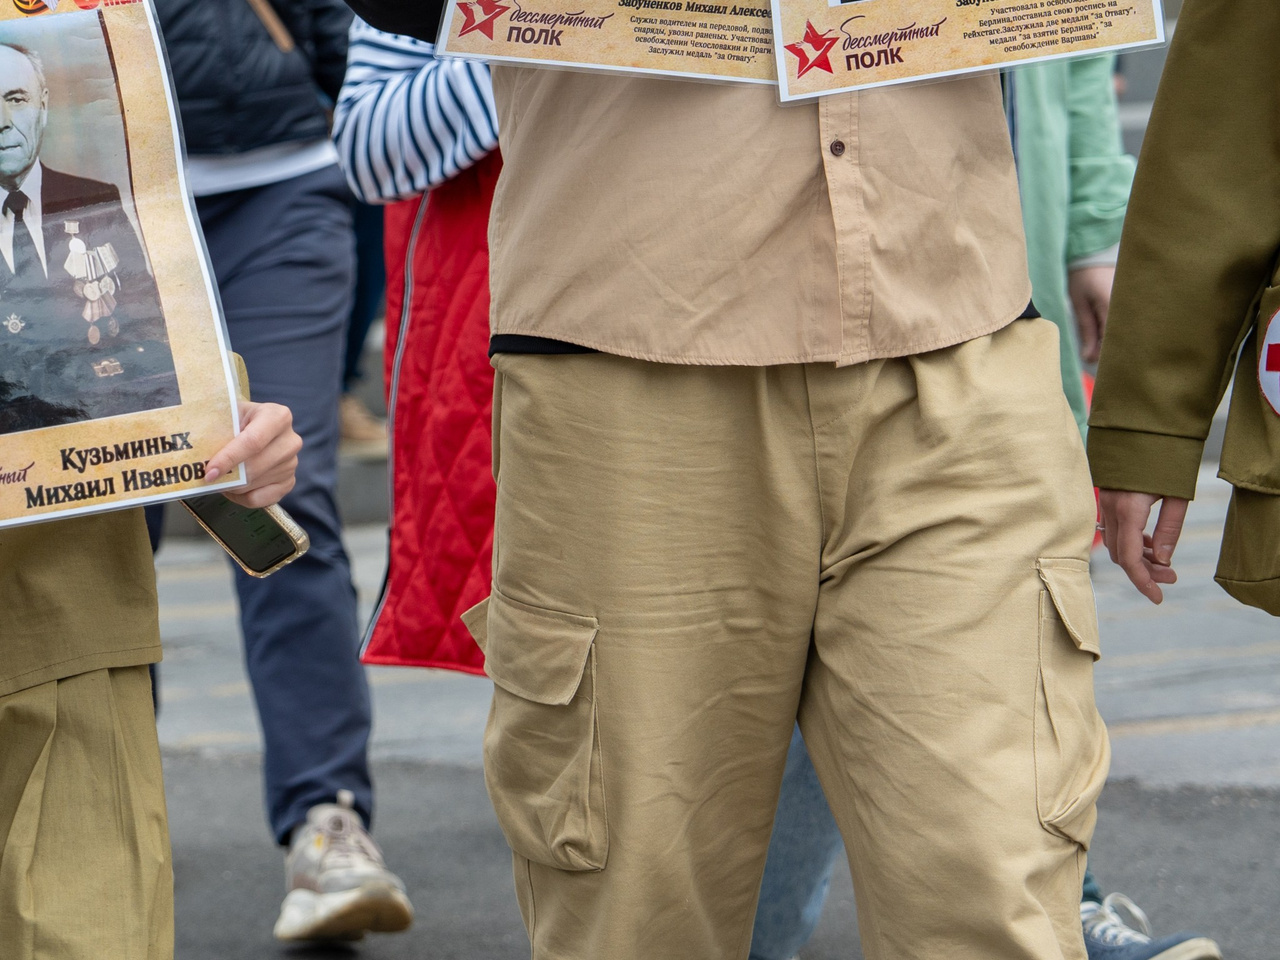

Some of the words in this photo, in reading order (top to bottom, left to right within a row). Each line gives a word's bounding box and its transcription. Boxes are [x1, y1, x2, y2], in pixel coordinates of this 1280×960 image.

[685, 1, 727, 15] Михаил
[990, 2, 1038, 15] Участвовала
[1054, 6, 1073, 16] свою
[1075, 2, 1106, 14] роспись
[630, 15, 657, 25] Служил
[659, 18, 697, 28] водителем
[710, 22, 749, 33] передовой,
[1046, 19, 1059, 28] две
[1061, 14, 1089, 25] медали
[506, 26, 564, 46] ПОЛК
[634, 27, 666, 36] снаряды,
[668, 29, 693, 38] увозил
[695, 31, 729, 41] раненых.
[839, 15, 947, 51] бессмертный
[989, 34, 1017, 45] медали
[1033, 29, 1059, 39] взятие
[635, 35, 688, 46] освобождении
[690, 41, 741, 51] Чехословакии
[1004, 38, 1059, 53] освобождение
[648, 46, 684, 56] Заслужил
[686, 50, 712, 58] медаль
[845, 47, 904, 71] ПОЛК
[60, 431, 194, 471] Кузьминых
[25, 476, 116, 510] Михаил
[122, 459, 233, 492] Иванов
